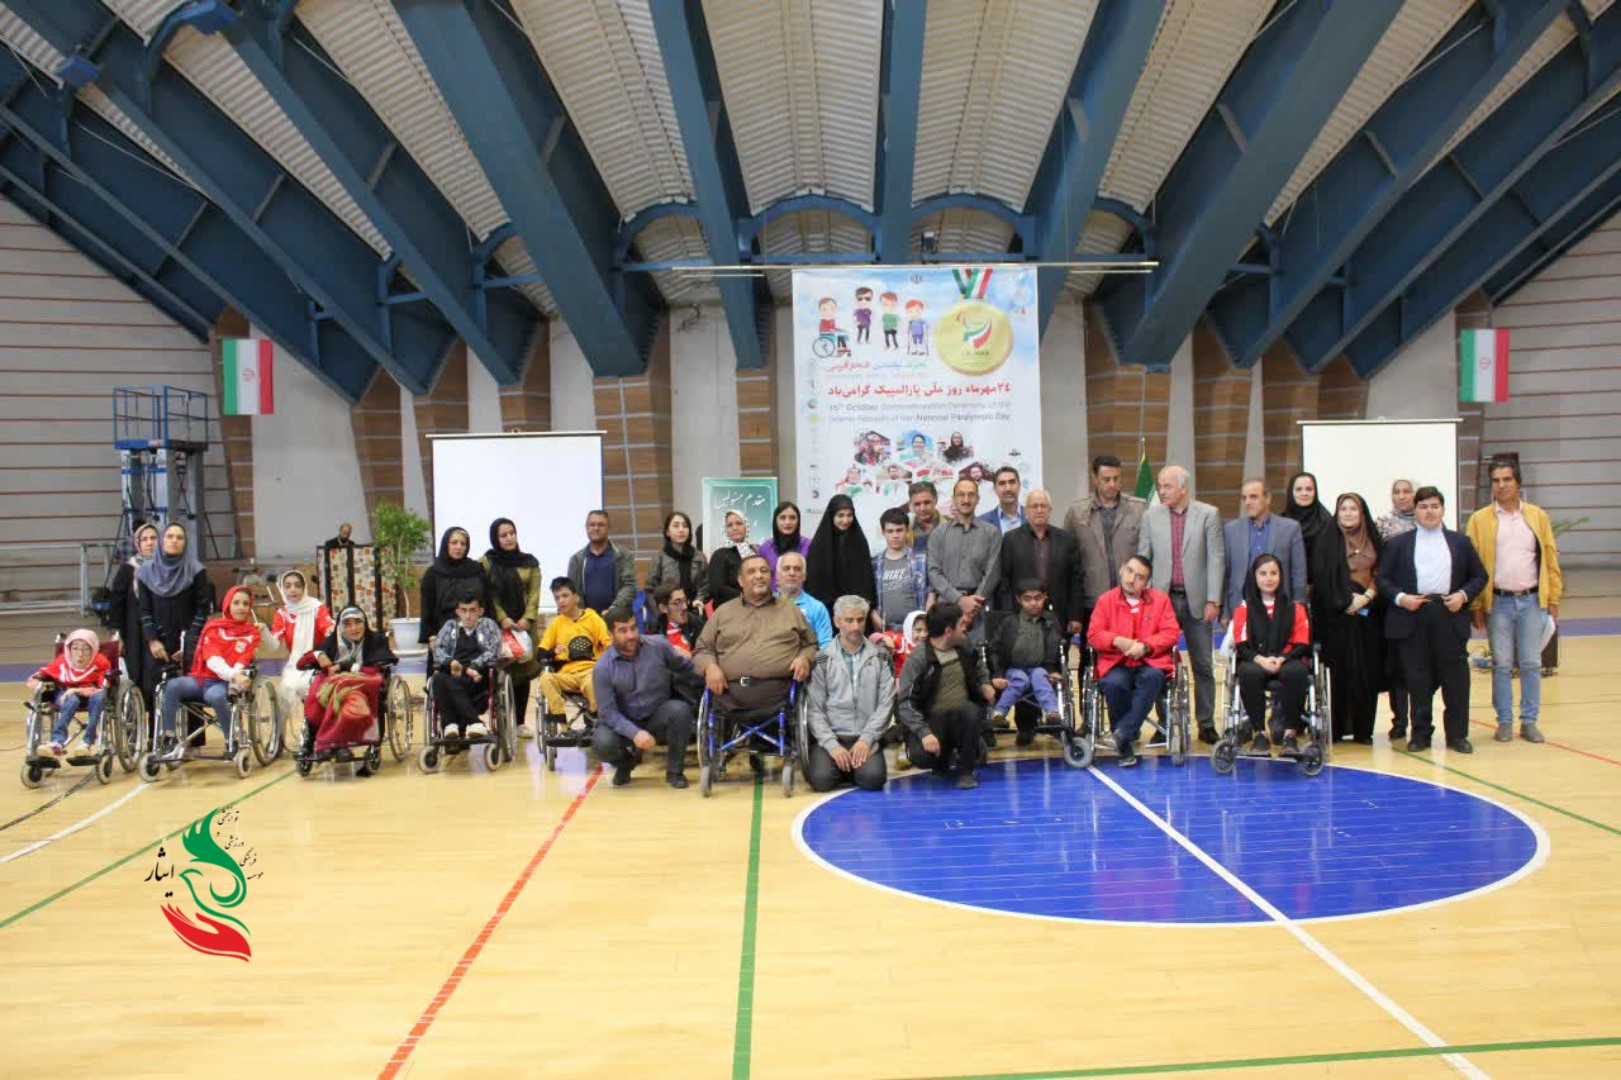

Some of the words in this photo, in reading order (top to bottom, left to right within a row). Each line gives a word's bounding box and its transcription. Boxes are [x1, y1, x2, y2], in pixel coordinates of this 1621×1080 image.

[874, 384, 920, 397] پارالمپیک
[947, 386, 962, 396] روز
[917, 413, 948, 421] National
[995, 412, 1010, 421] Day
